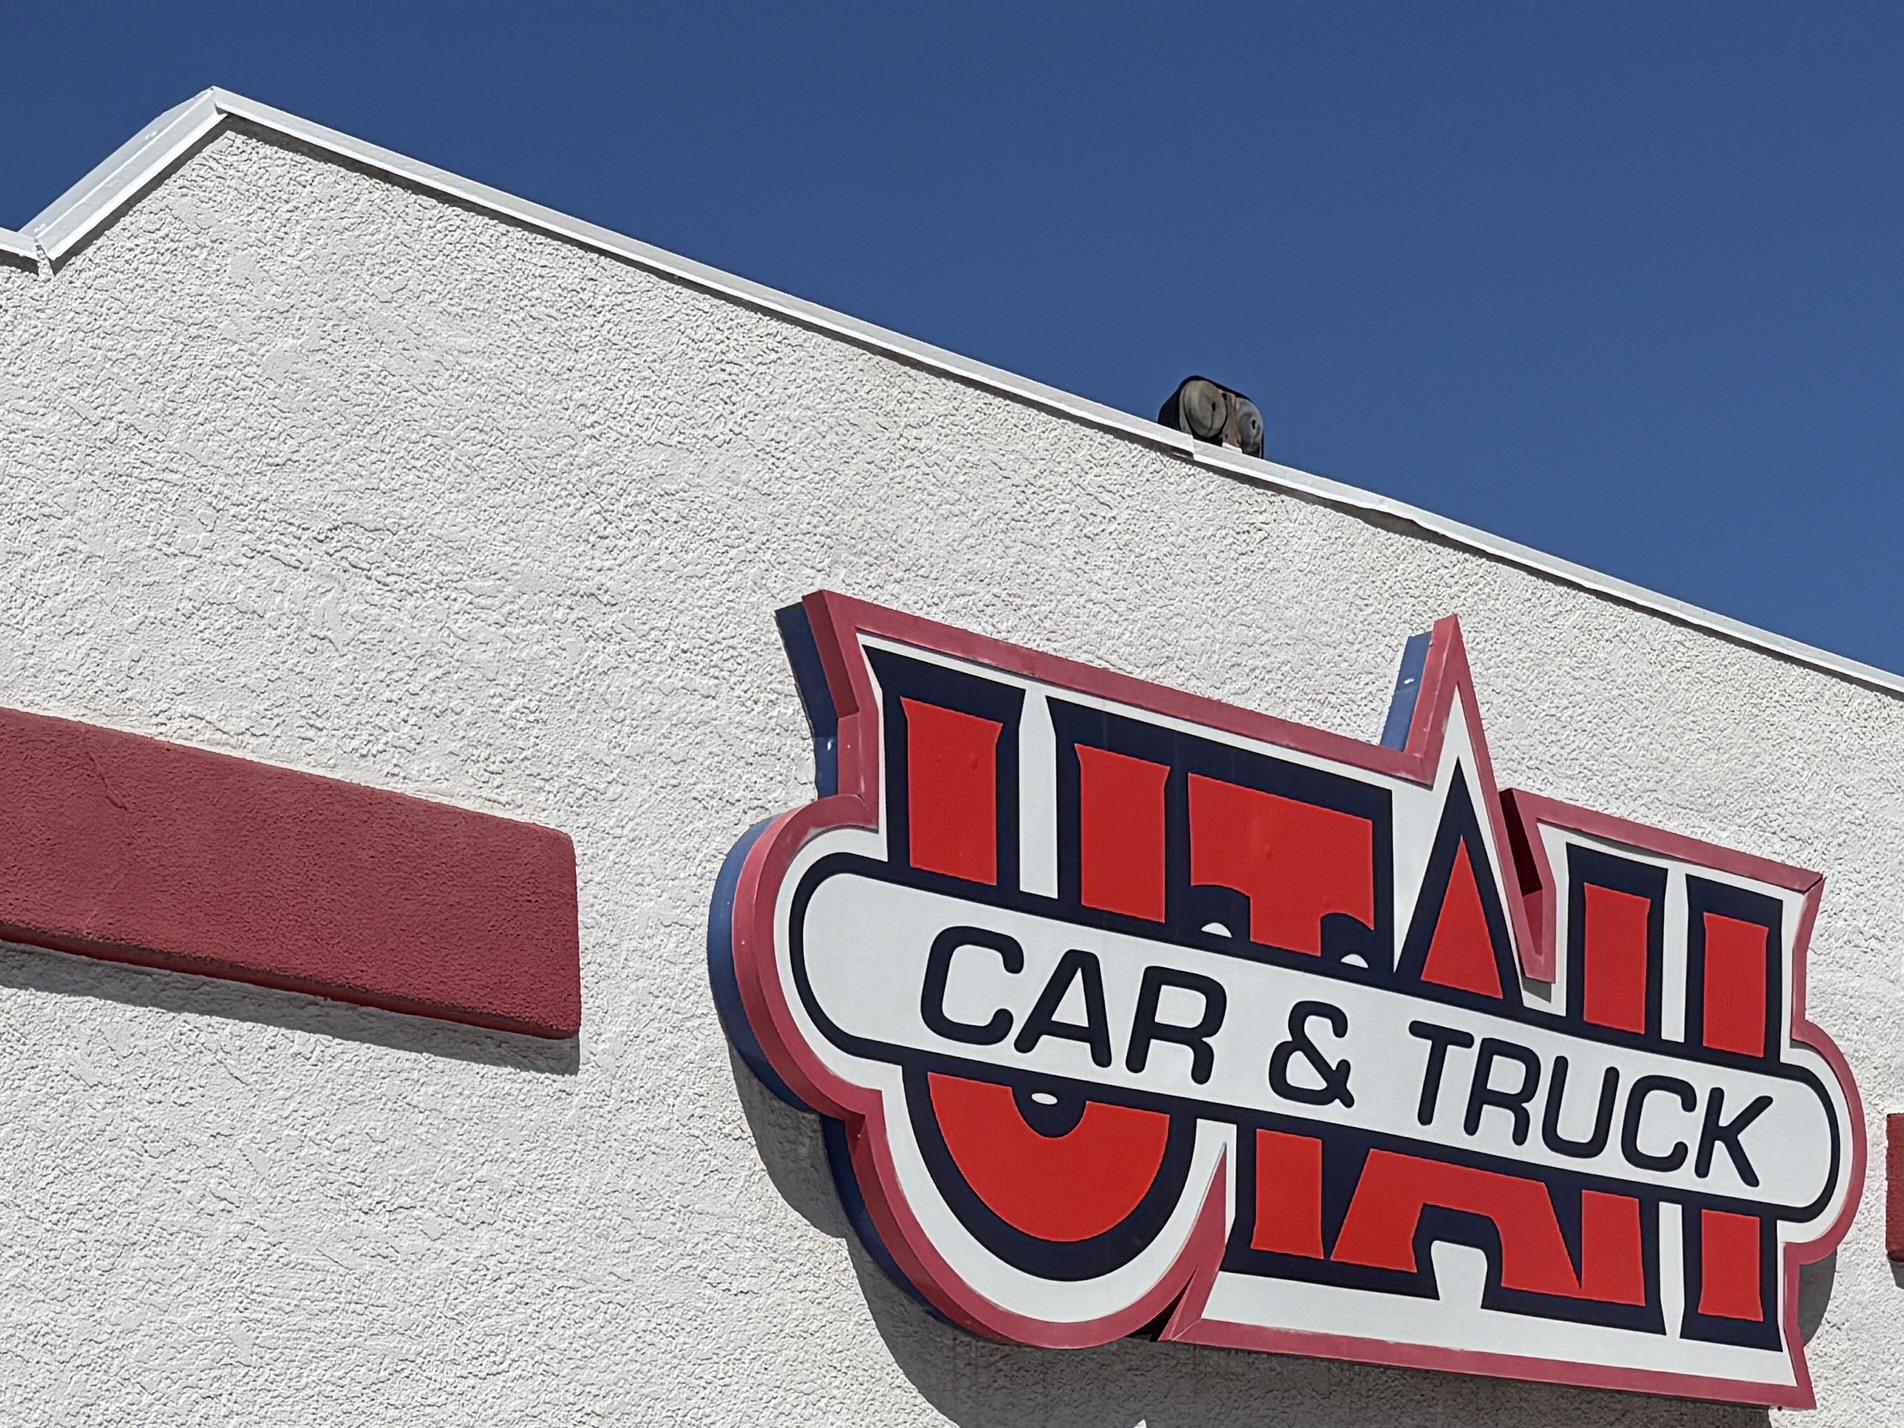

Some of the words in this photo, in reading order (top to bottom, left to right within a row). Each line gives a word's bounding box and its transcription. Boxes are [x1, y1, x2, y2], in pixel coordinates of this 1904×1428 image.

[862, 645, 1784, 1353] UTAH
[919, 924, 1234, 1086] CAR
[1267, 998, 1355, 1107] &
[1407, 1019, 1774, 1189] TRUCK
